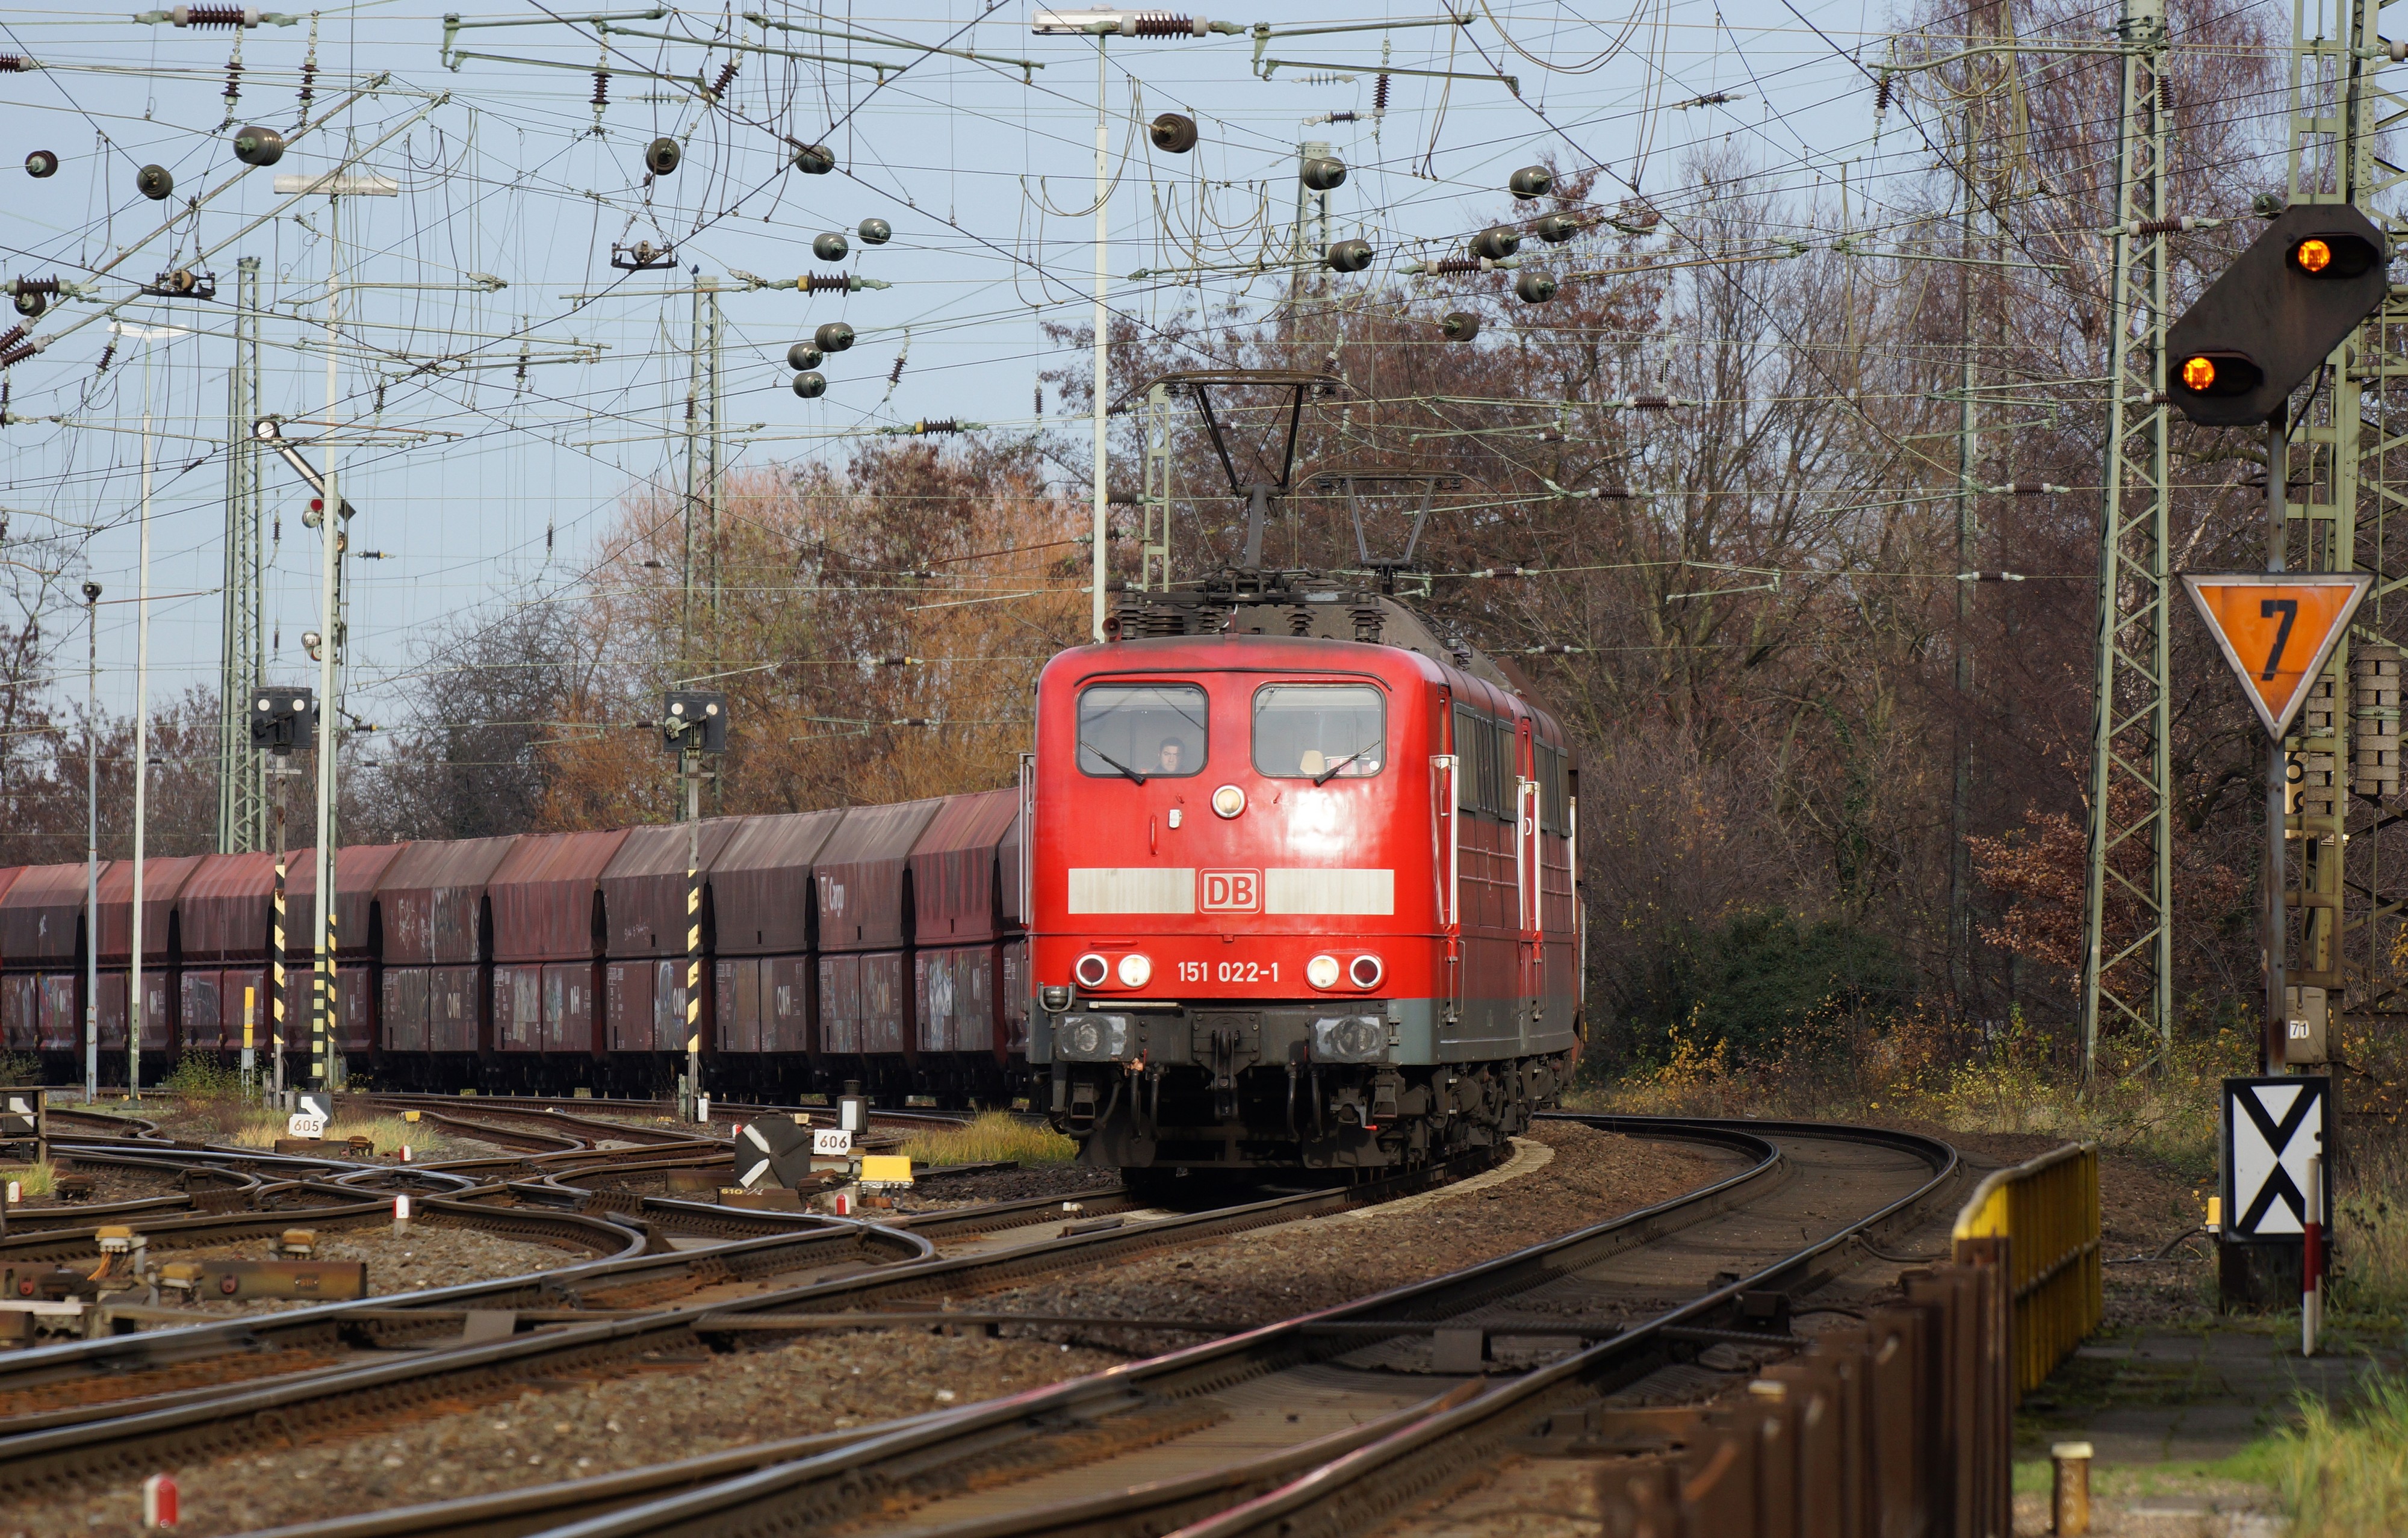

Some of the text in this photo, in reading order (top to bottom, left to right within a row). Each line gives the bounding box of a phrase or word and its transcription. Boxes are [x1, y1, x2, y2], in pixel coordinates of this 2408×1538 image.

[2261, 600, 2298, 681] 7
[829, 876, 844, 918] Cargo
[1208, 876, 1253, 905] DB
[1178, 962, 1278, 982] 151 022-1
[2291, 1023, 2306, 1035] 71
[294, 1120, 319, 1132] 605
[820, 1135, 848, 1149] 606
